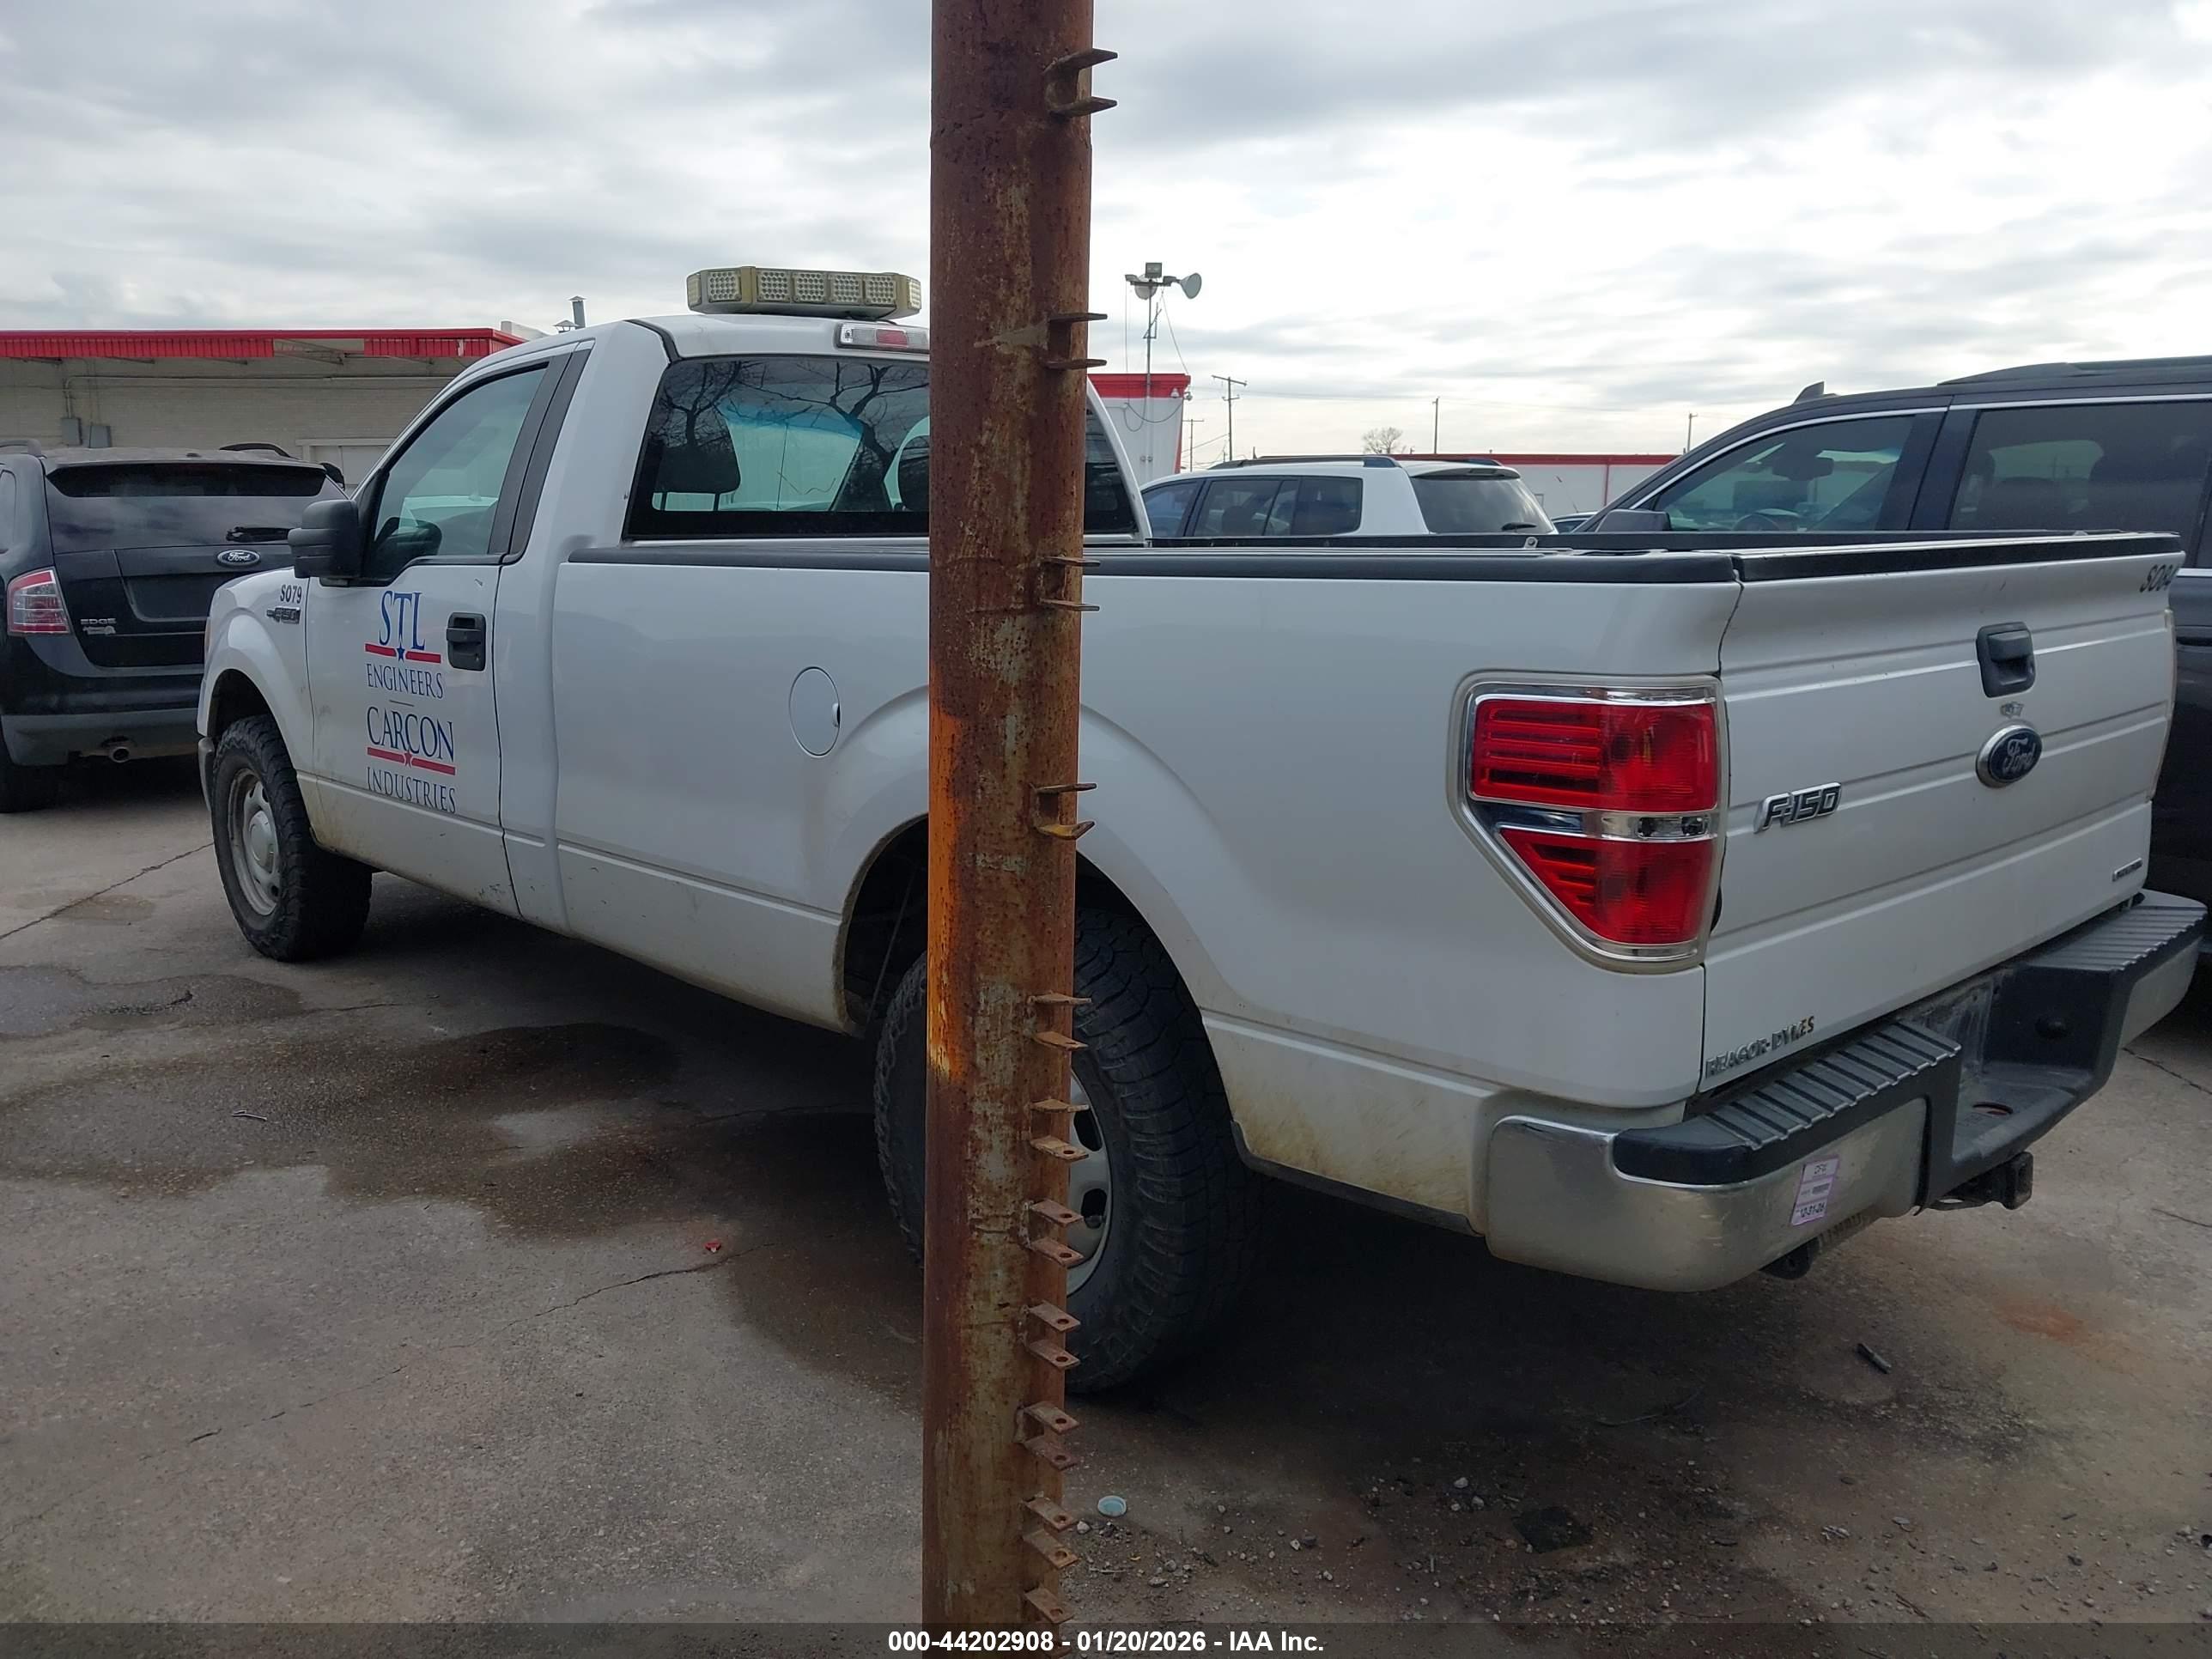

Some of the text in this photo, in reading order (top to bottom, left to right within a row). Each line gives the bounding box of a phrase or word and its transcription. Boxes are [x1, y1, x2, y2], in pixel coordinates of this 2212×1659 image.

[228, 551, 251, 562] Ford
[379, 590, 426, 651] STL
[366, 663, 444, 699] ENGINEERS
[367, 706, 456, 763] CARCON
[2002, 738, 2037, 774] Ford
[367, 766, 456, 813] INDUSTRIES
